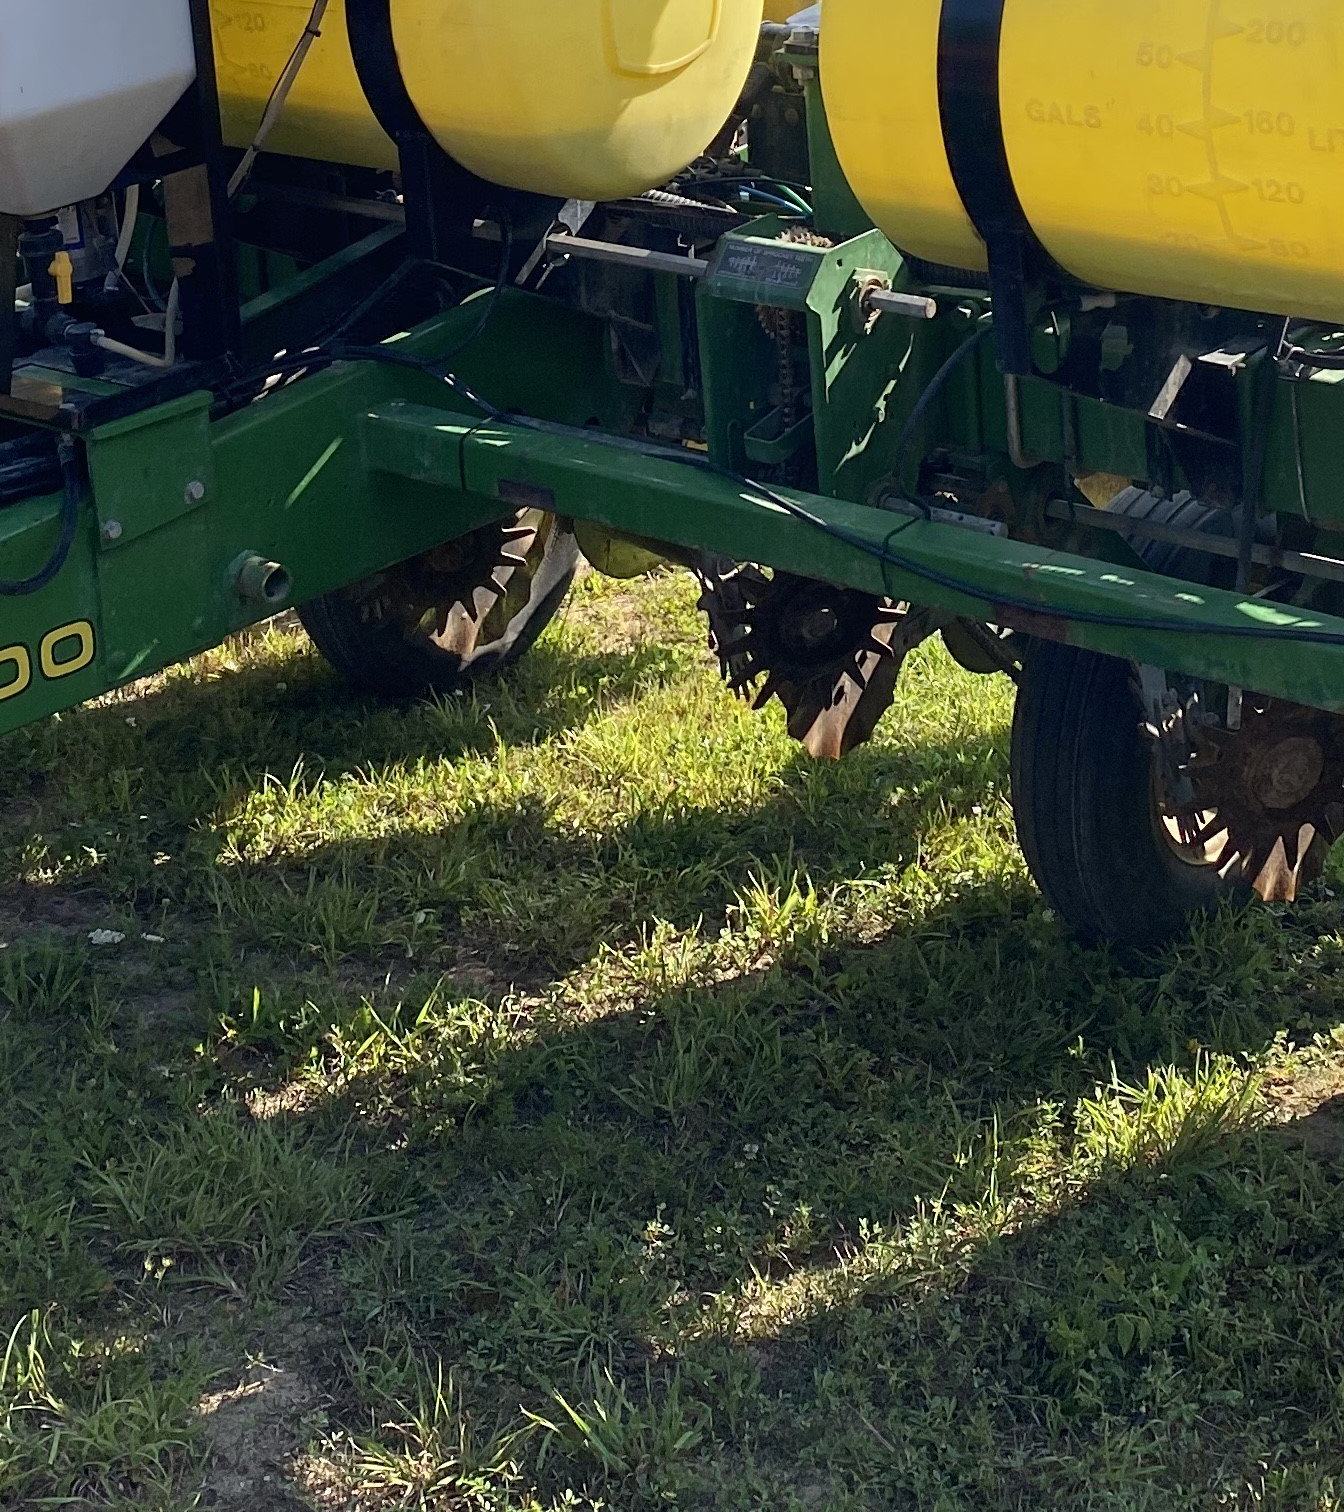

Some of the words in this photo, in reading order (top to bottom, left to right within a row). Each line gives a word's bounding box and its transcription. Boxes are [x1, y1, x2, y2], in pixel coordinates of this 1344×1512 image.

[1245, 18, 1308, 47] 200
[1135, 41, 1175, 70] 50
[1024, 97, 1103, 129] GALS
[1135, 111, 1175, 139] 40
[1242, 108, 1296, 137] 160
[1250, 177, 1306, 206] 120
